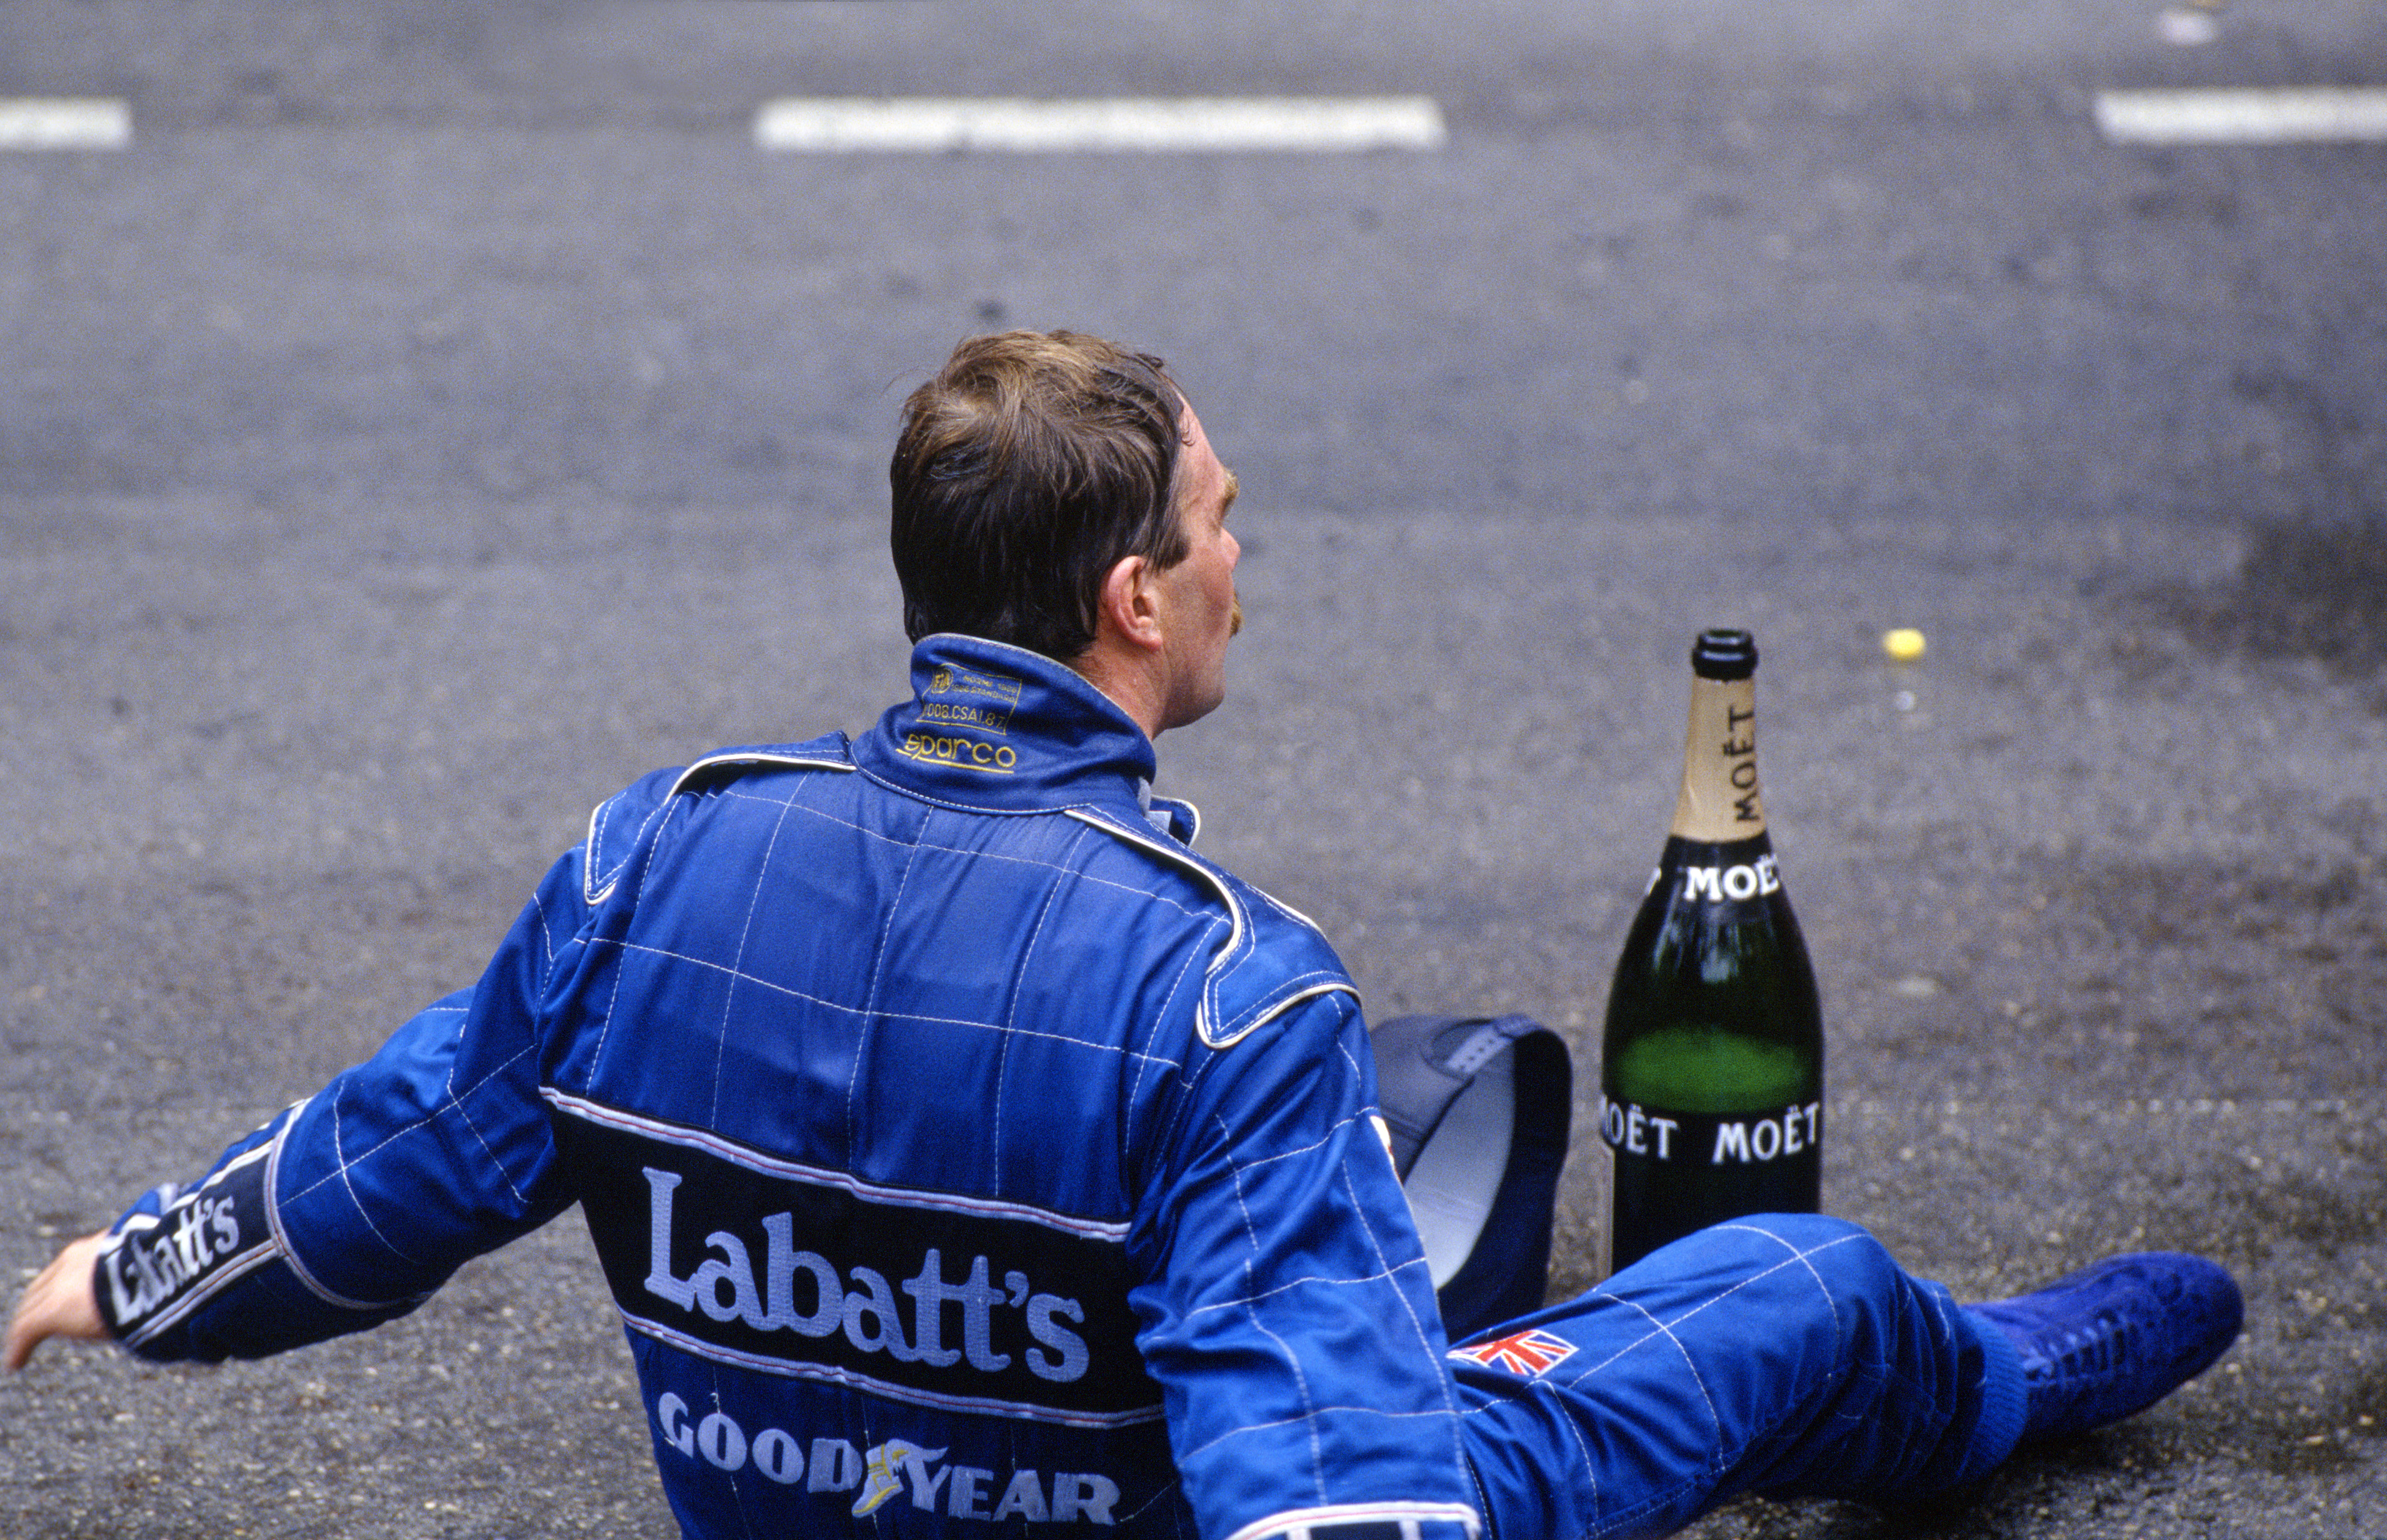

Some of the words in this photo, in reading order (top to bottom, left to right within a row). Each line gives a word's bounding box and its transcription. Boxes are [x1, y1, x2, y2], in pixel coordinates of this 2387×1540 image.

[904, 734, 1016, 768] sparco
[1722, 705, 1759, 822] MOËT
[1684, 853, 1780, 901] MOË
[1600, 1095, 1679, 1160] OËT
[1712, 1102, 1819, 1163] MOËT
[642, 1166, 1090, 1382] Labatt's
[658, 1392, 1122, 1525] GOODYEAR
